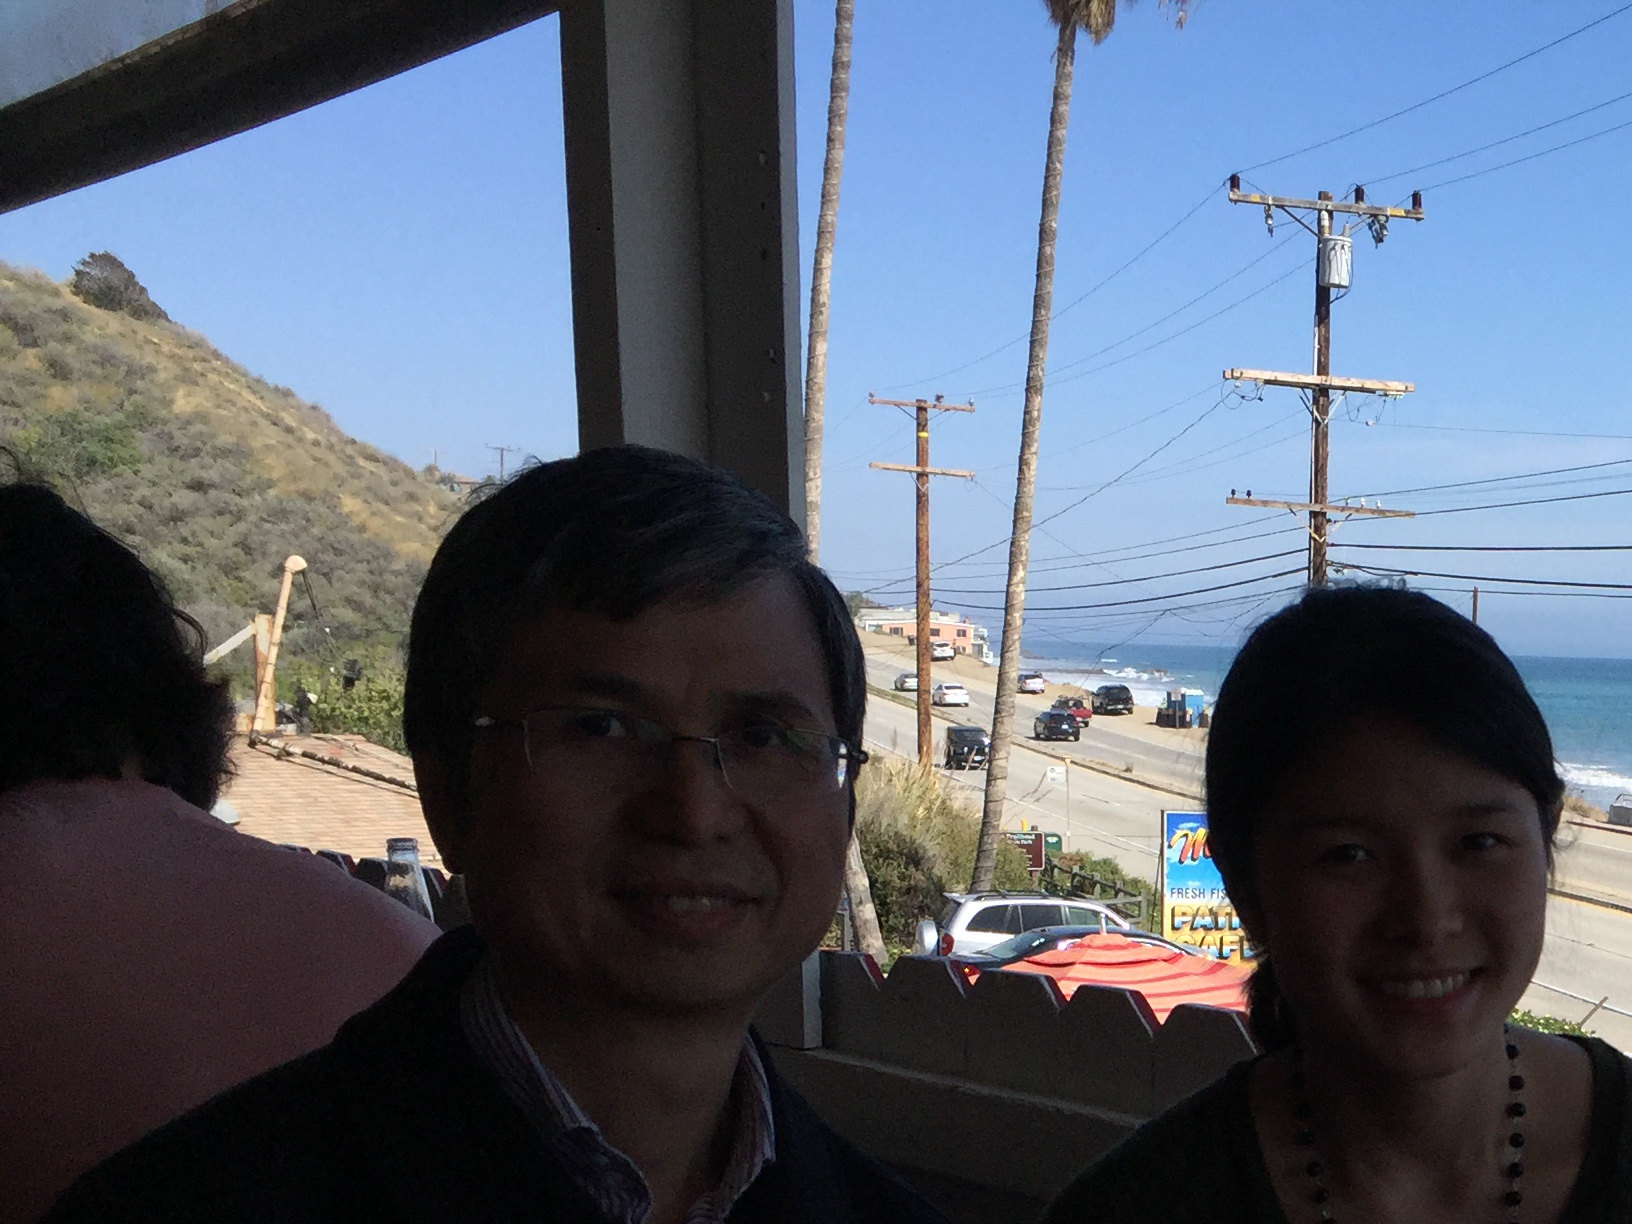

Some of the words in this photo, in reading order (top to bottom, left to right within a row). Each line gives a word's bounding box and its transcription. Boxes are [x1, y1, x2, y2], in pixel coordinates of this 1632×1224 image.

[1170, 887, 1206, 899] FRESH
[1210, 888, 1228, 900] FIS
[1171, 905, 1242, 931] PATI
